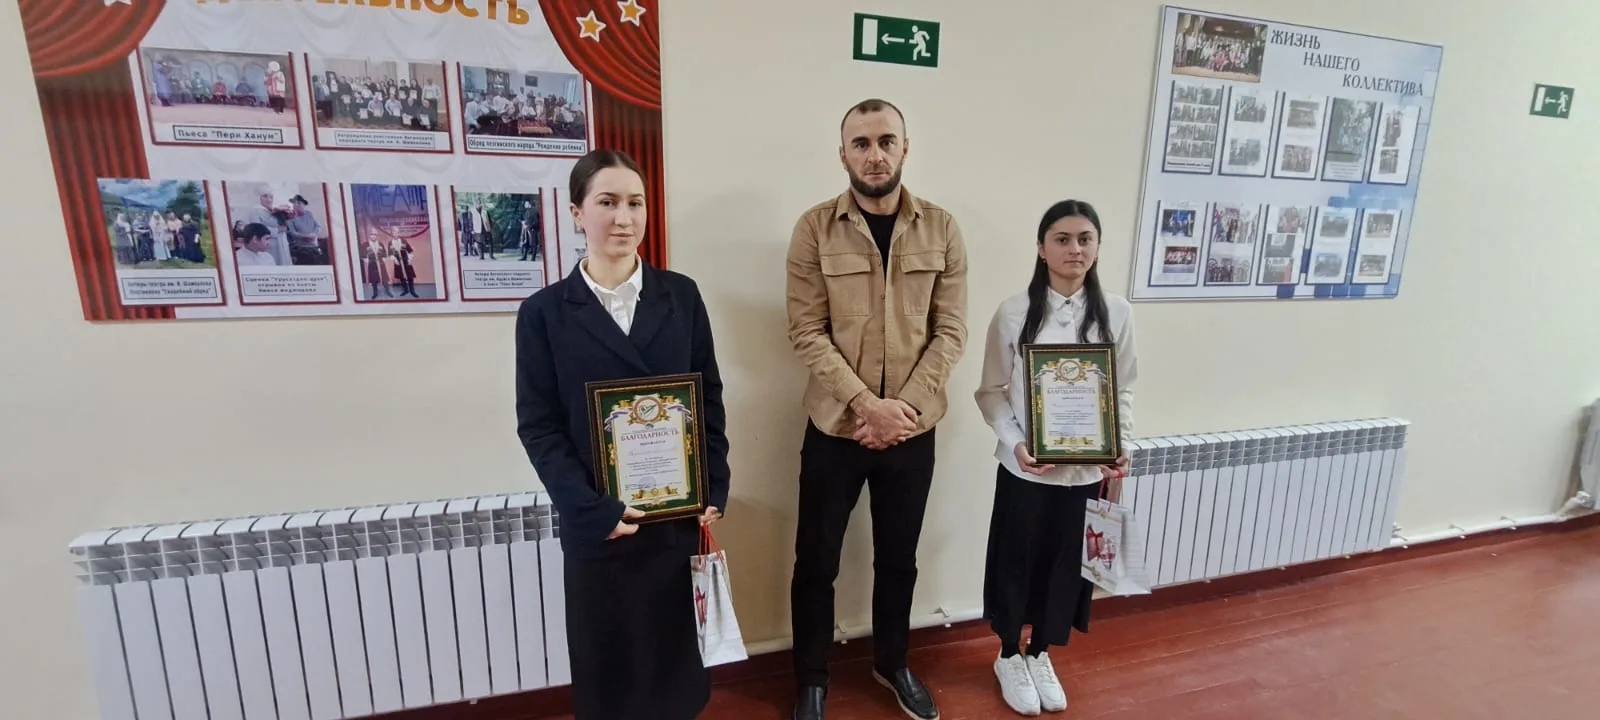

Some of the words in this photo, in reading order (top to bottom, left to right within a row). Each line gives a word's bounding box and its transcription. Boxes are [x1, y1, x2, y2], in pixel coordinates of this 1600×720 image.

[1270, 29, 1321, 50] ЖИЗНЬ
[1303, 51, 1361, 71] НАШЕГО
[1342, 73, 1424, 97] КОЛЛЕКТИВА
[178, 129, 208, 138] Пьеса
[211, 130, 241, 140] "Пери
[245, 131, 279, 141] Ханум"
